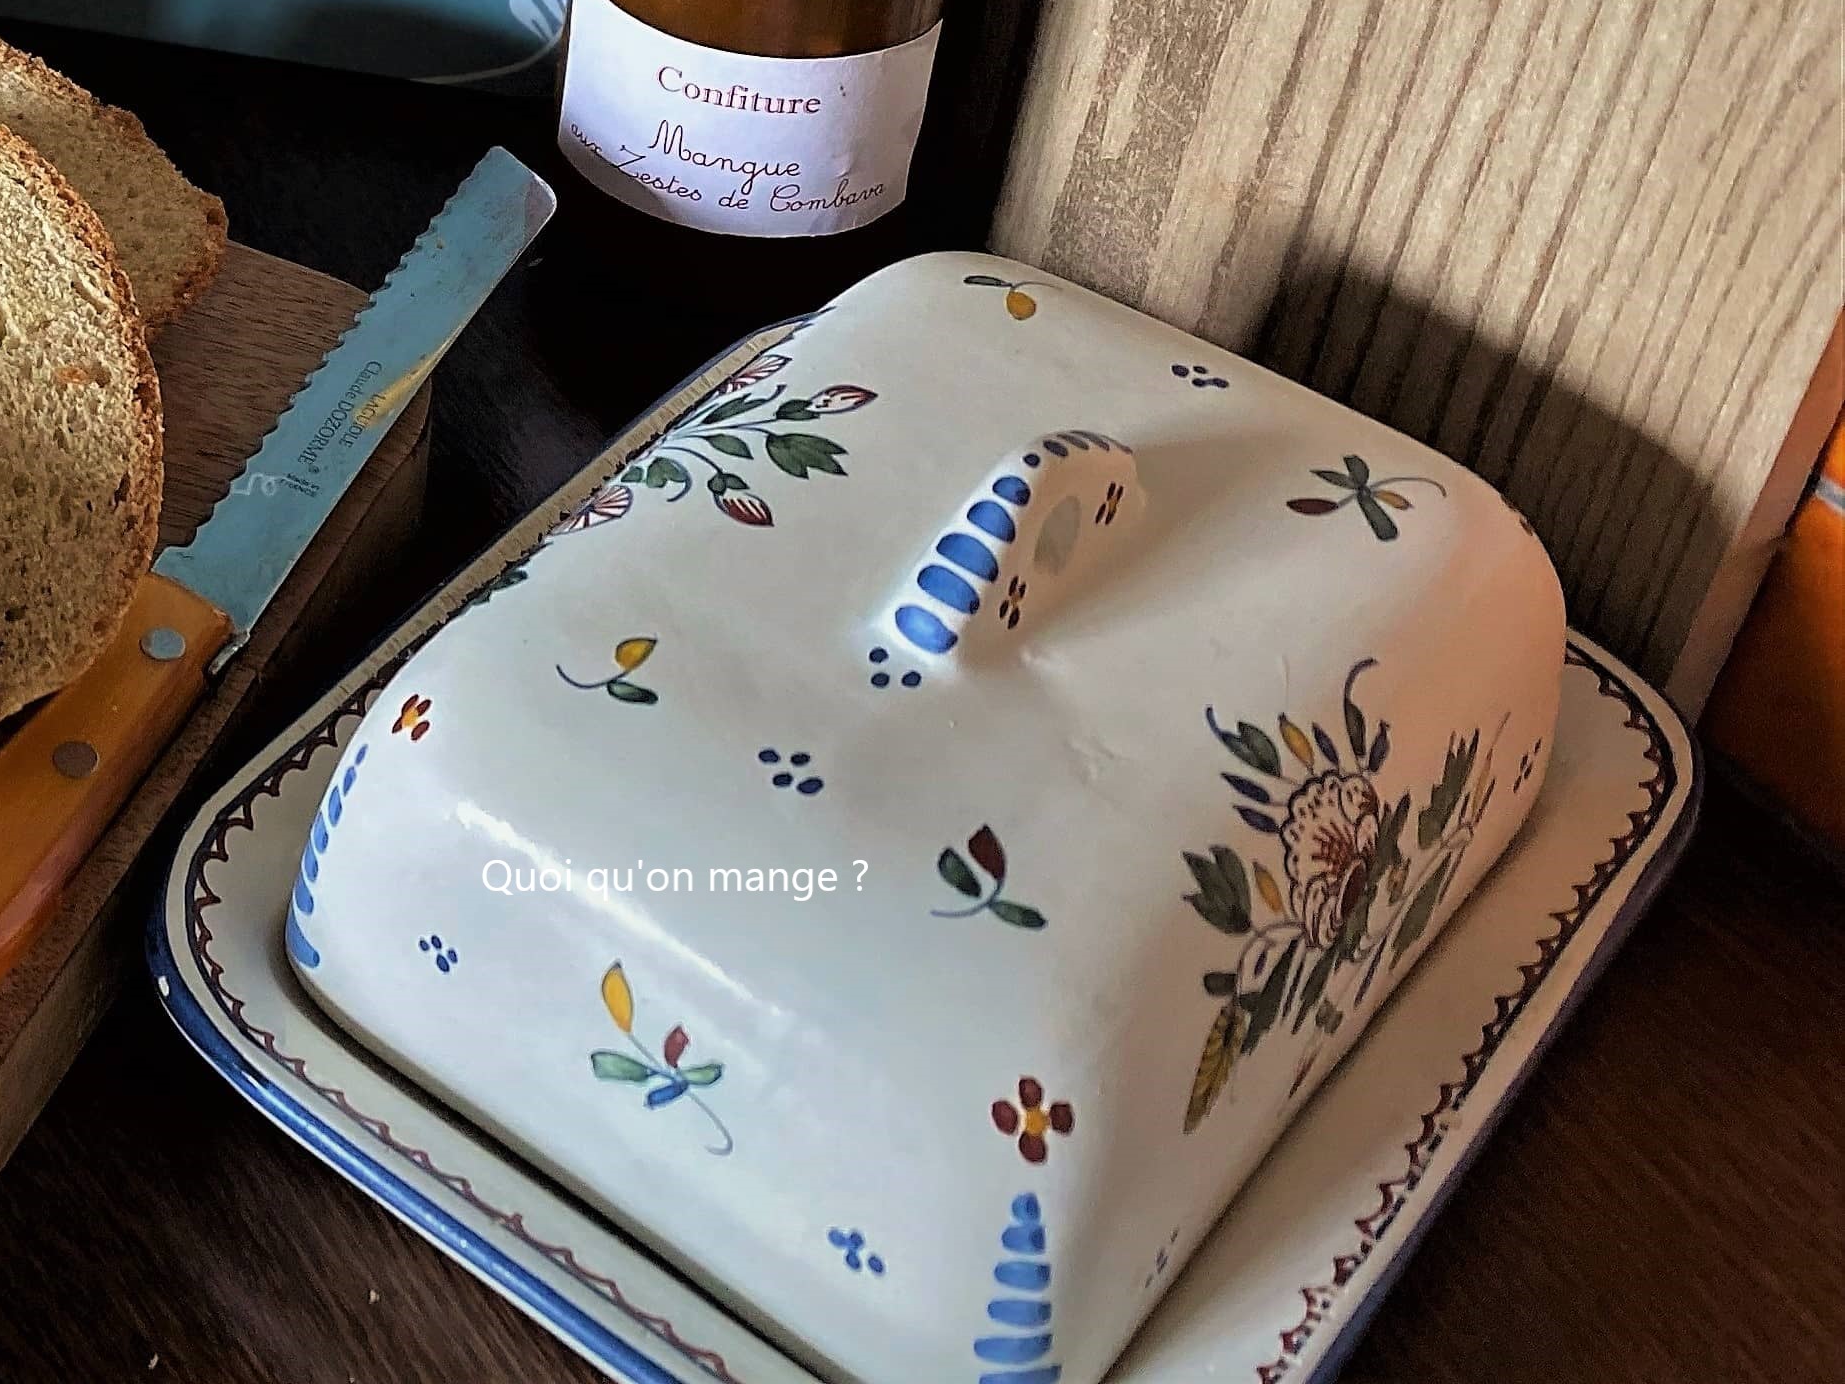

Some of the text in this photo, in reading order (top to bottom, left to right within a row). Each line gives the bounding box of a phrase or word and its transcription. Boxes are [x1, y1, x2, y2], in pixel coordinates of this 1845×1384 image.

[656, 64, 822, 115] Confiture
[570, 121, 605, 159] aux
[613, 143, 703, 203] Zestes
[718, 186, 751, 211] de
[648, 118, 802, 196] Mangue
[345, 360, 384, 400] Claude
[340, 393, 387, 449] LAGUIOLE
